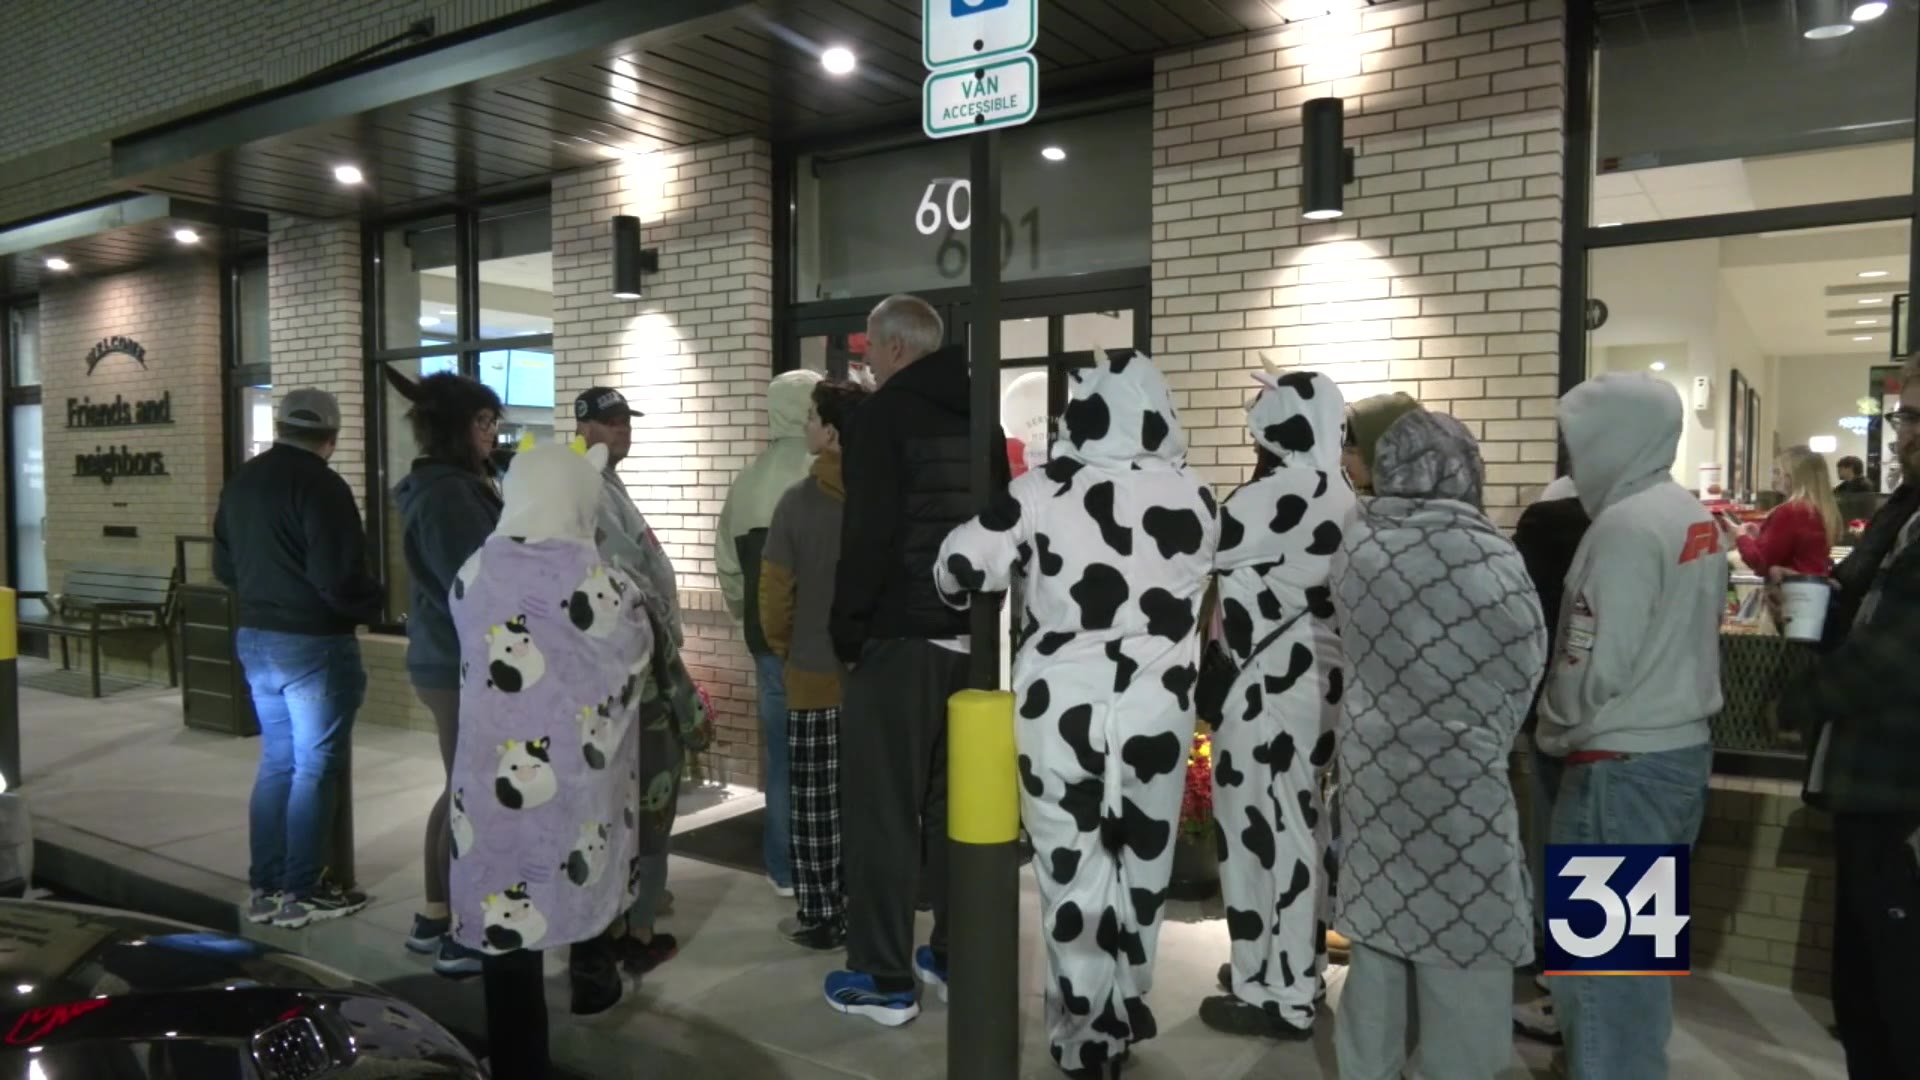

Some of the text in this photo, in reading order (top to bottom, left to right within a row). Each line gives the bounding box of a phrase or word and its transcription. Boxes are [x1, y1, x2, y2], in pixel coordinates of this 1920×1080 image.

[961, 75, 999, 99] VAN
[943, 94, 1017, 120] ACCESSIBLE
[67, 390, 170, 427] Friends and
[75, 445, 165, 485] neighbors
